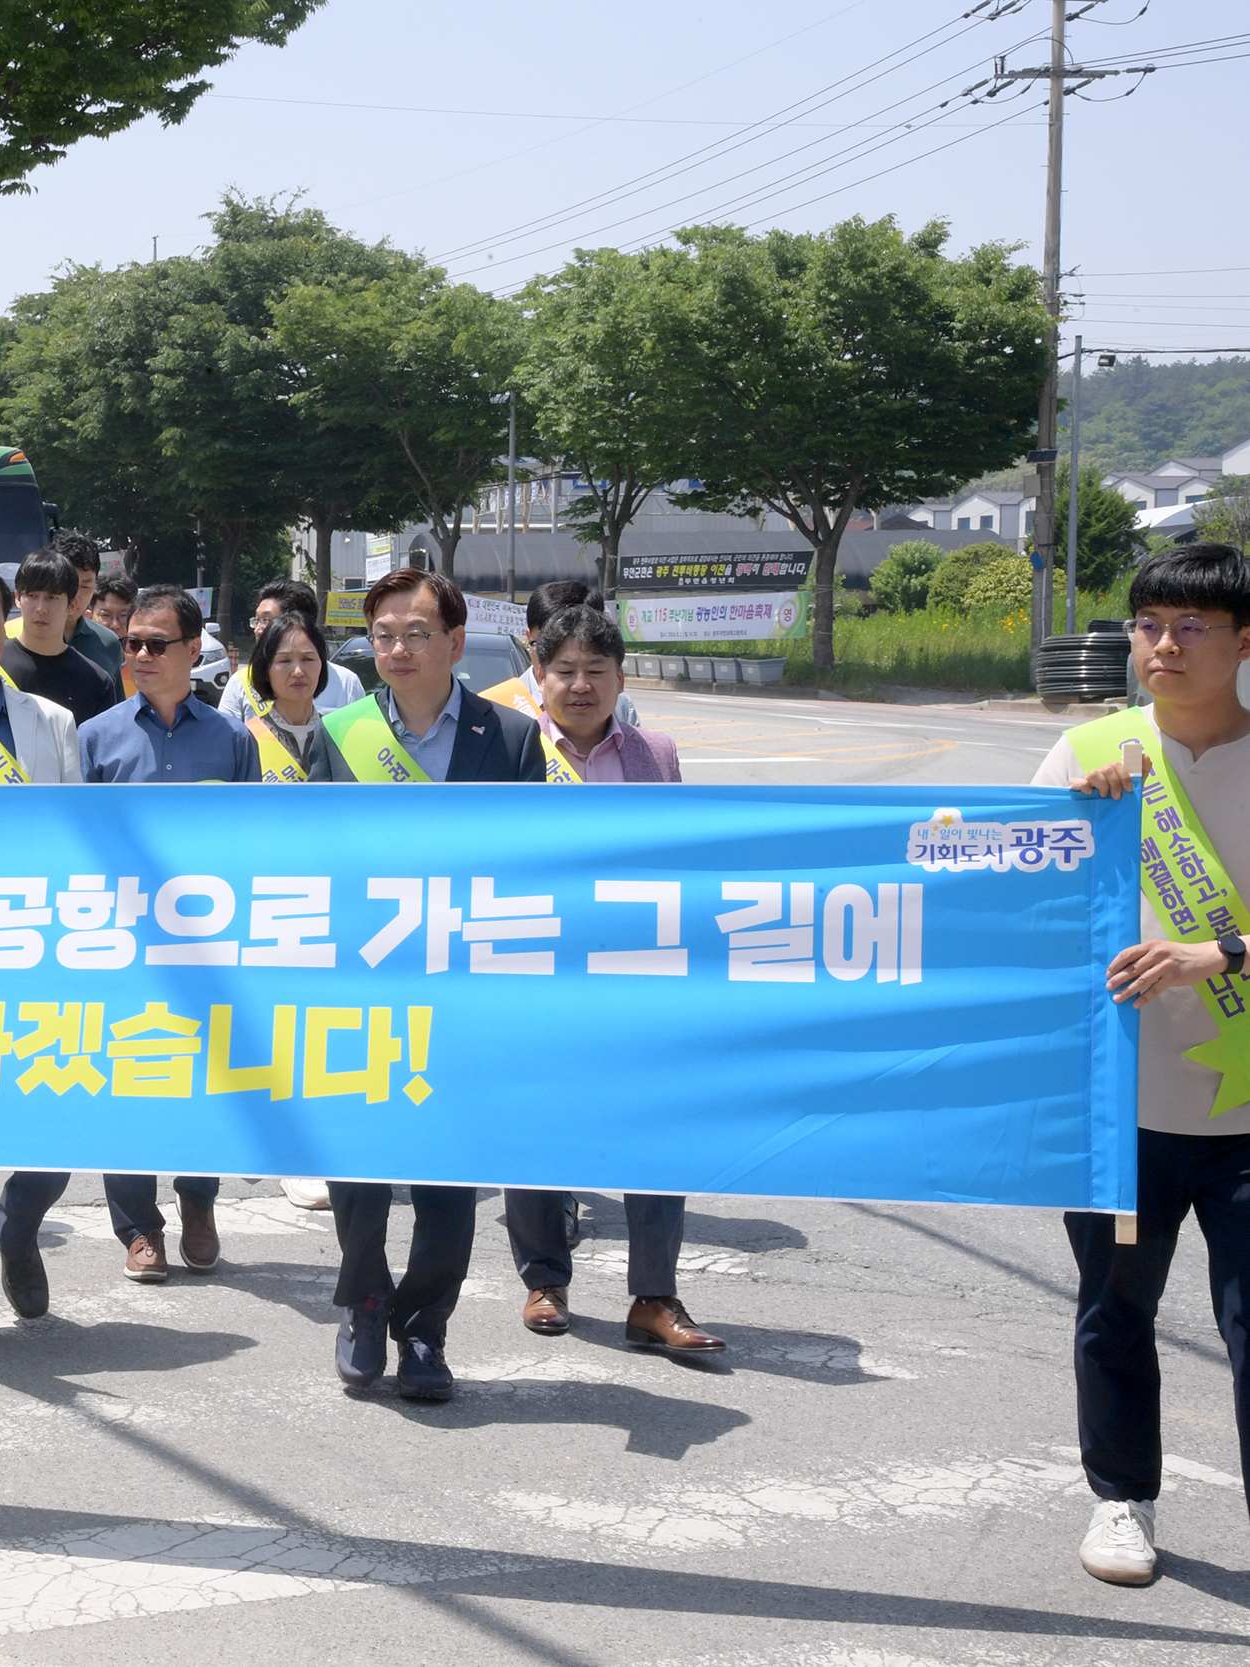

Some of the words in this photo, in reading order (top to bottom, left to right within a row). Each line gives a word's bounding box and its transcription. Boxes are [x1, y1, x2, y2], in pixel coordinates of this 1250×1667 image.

[623, 566, 653, 579] 무안군민은
[656, 565, 670, 578] 광주
[672, 564, 708, 577] 전투비행장
[710, 563, 733, 576] 이전을
[641, 610, 652, 623] 개교
[654, 608, 668, 622] 115
[668, 608, 694, 622] 주년기념
[729, 603, 773, 621] 한마음축제
[783, 608, 792, 622] 영
[914, 843, 1004, 865] 기회도시
[1009, 827, 1087, 865] 광주
[917, 828, 929, 841] 내
[939, 828, 962, 841] 일이
[967, 828, 1003, 841] 빛나는
[1152, 805, 1229, 905] 해소하고,
[1140, 836, 1200, 936] 해결하면
[358, 876, 561, 975] 가는
[587, 880, 688, 976] 그
[714, 880, 923, 985] 길에
